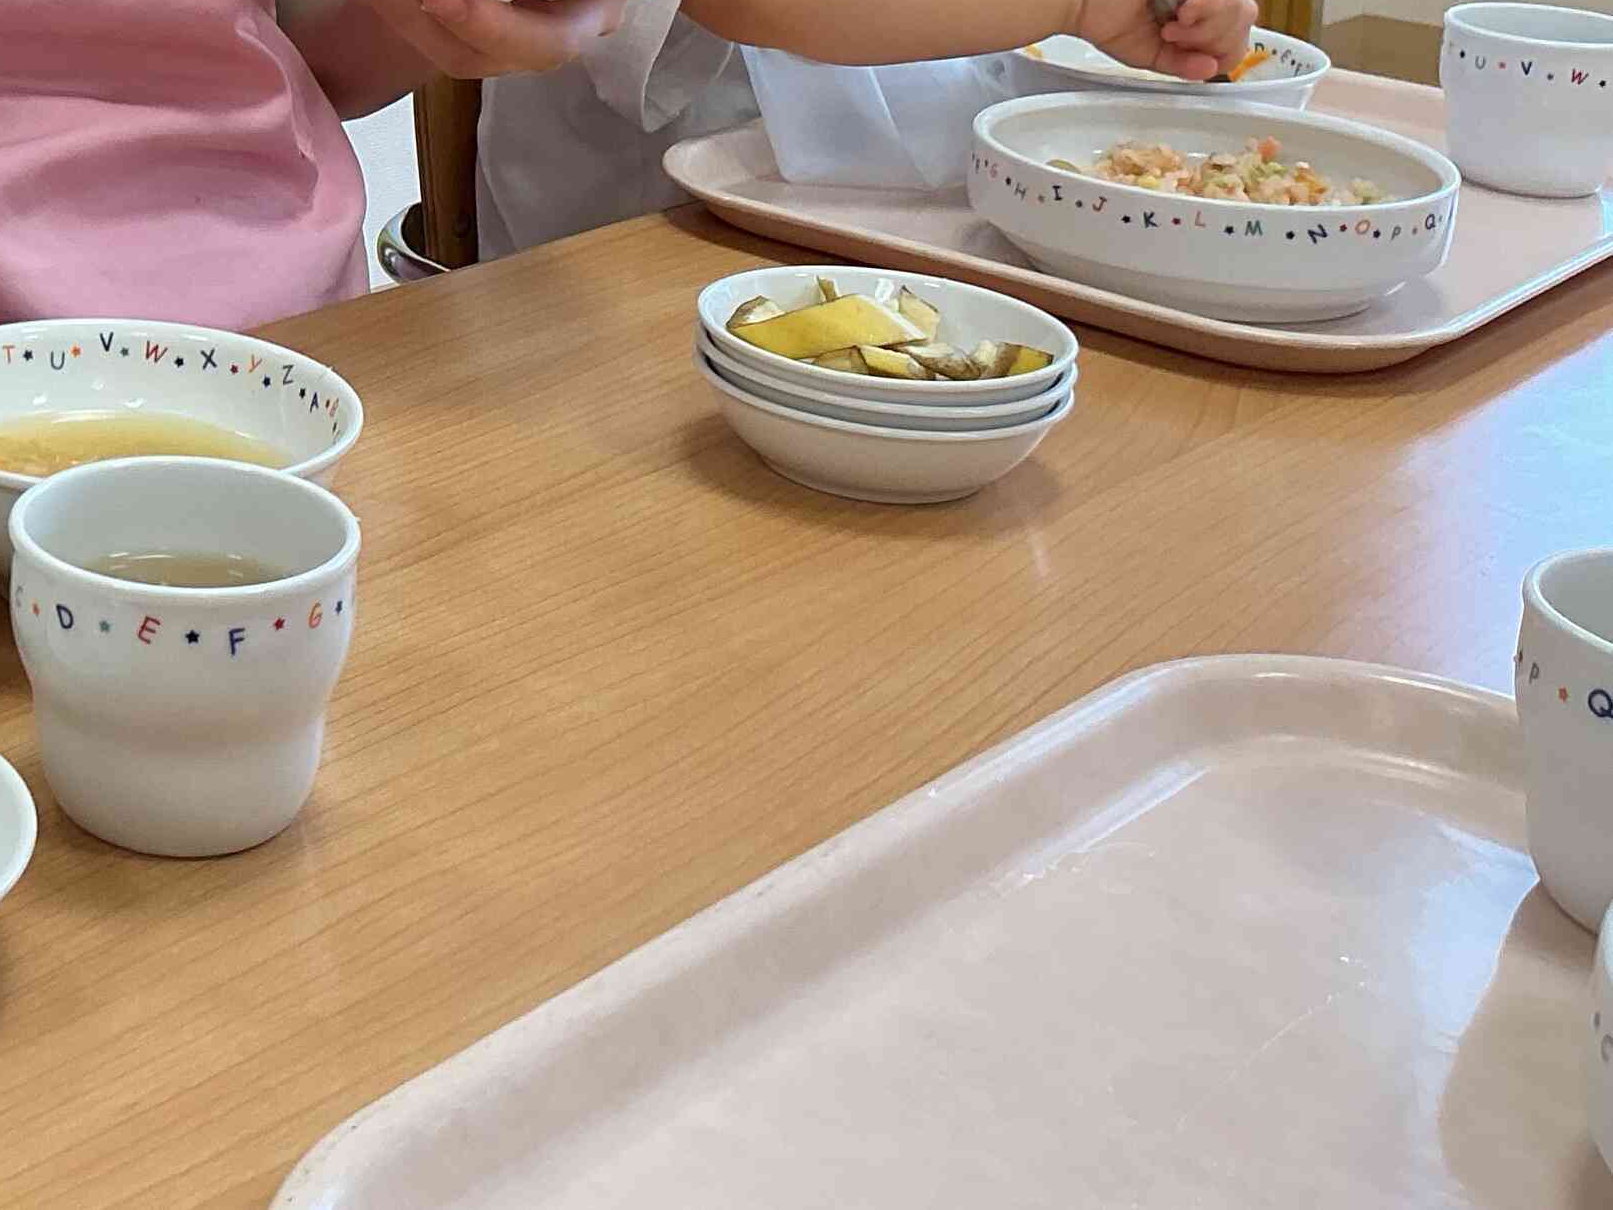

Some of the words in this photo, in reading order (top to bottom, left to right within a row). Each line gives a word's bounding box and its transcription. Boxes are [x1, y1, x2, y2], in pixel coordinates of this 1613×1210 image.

[1475, 56, 1486, 70] U
[1522, 62, 1532, 75] V
[1572, 70, 1588, 84] W
[1015, 183, 1026, 198] H
[1053, 186, 1062, 200] I
[1093, 197, 1107, 211] J
[1144, 212, 1157, 227] K
[1195, 211, 1206, 227] L
[1245, 221, 1262, 235] M
[1308, 225, 1327, 243] N
[1355, 220, 1370, 234] O
[1391, 226, 1401, 240] P
[1425, 214, 1435, 230] Q
[2, 345, 16, 364] T
[51, 352, 65, 369] U
[100, 333, 113, 351] V
[146, 341, 167, 362] W
[200, 348, 218, 370] X
[248, 354, 263, 374] Y
[283, 365, 293, 385] Z
[310, 393, 318, 412] A
[56, 604, 73, 629] D
[138, 616, 160, 644] E
[229, 628, 245, 655] F
[309, 603, 322, 628] G
[1588, 690, 1613, 718] Q
